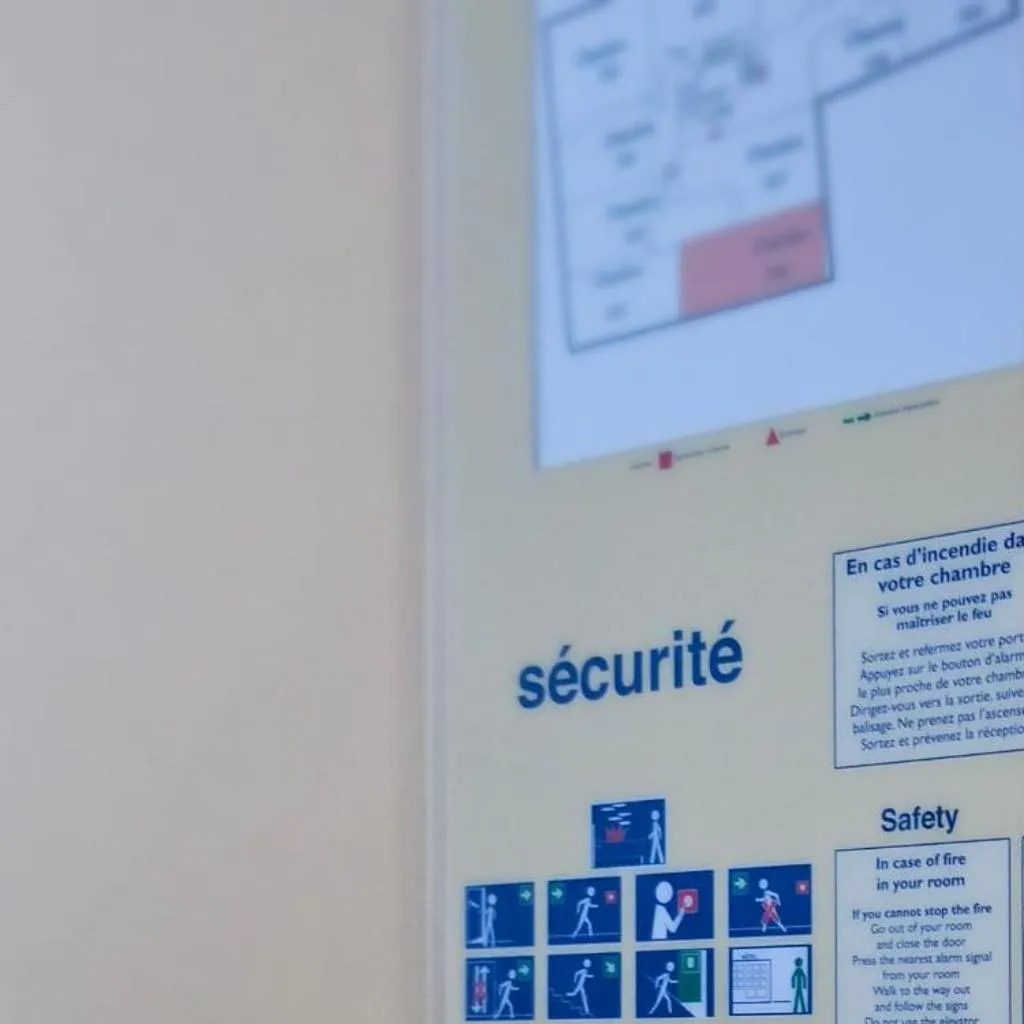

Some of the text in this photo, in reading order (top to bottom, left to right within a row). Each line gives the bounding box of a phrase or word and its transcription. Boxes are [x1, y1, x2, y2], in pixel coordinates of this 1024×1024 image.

[845, 555, 868, 576] En
[872, 554, 900, 571] cas
[905, 534, 997, 566] d'incendie
[878, 556, 1011, 593] votre chambre
[876, 588, 1012, 618] Si vous ne pouvez pas
[895, 605, 992, 631] maîtriser le feu
[517, 618, 743, 709] sécurité
[880, 805, 959, 834] Safety
[875, 850, 966, 870] In case of fire
[875, 875, 965, 893] in your room
[861, 909, 882, 923] you
[883, 905, 922, 918] cannot
[923, 904, 948, 919] stop
[950, 901, 970, 915] the
[972, 900, 992, 914] fire
